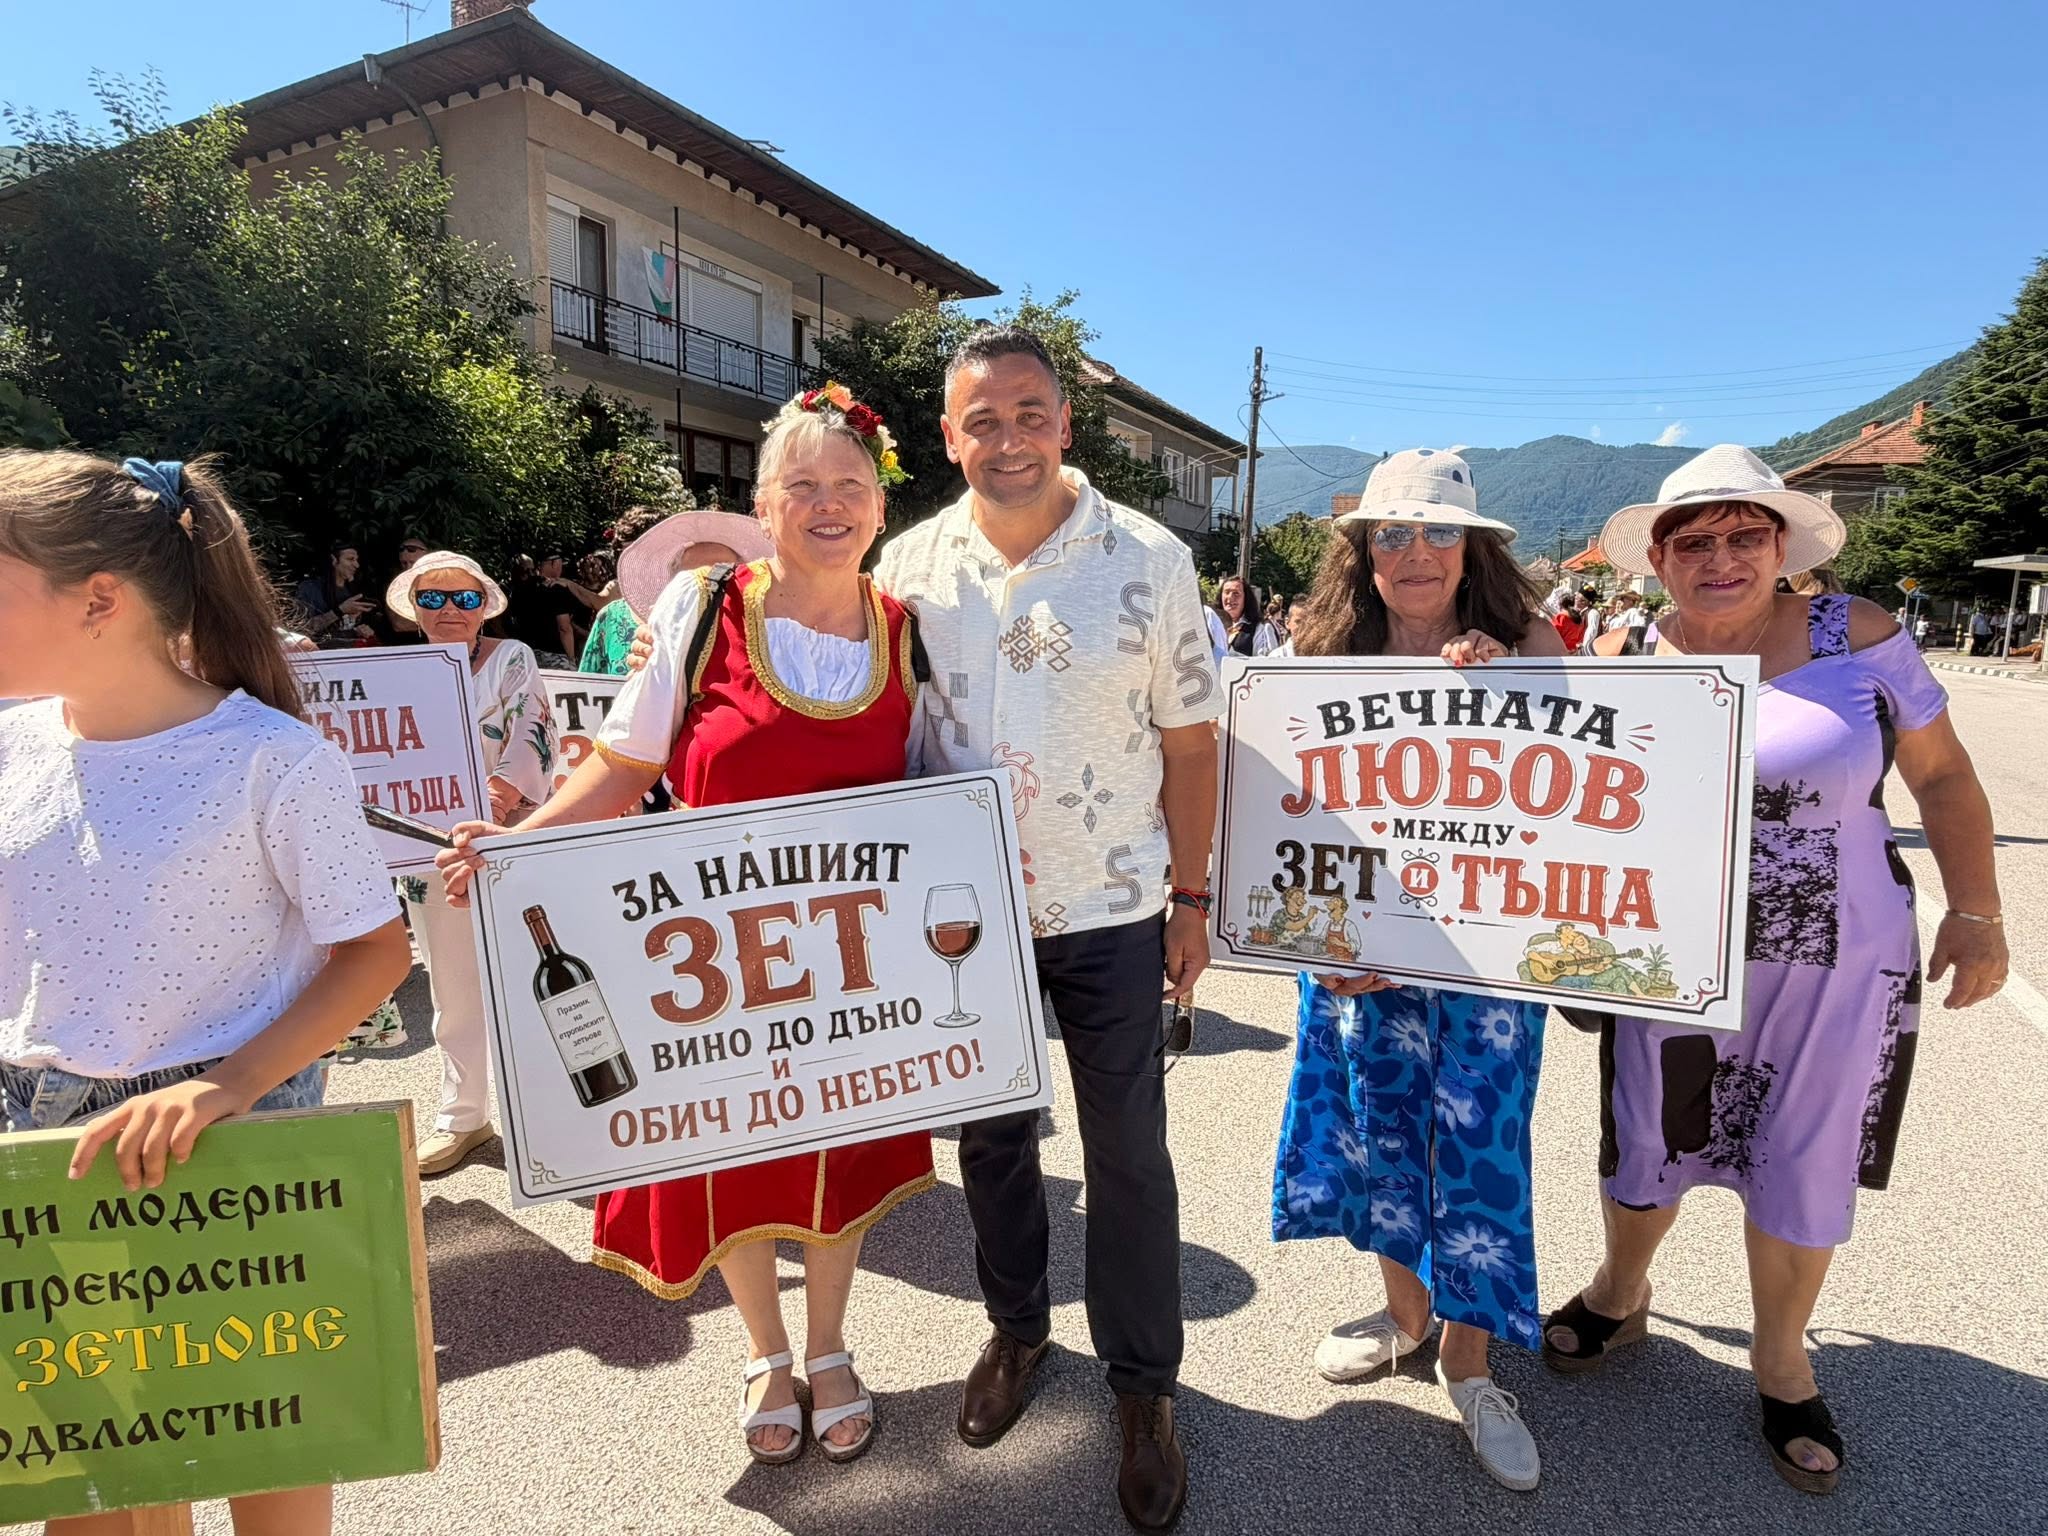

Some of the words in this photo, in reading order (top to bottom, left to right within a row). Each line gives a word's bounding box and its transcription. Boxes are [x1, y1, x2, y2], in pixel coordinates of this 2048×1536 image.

[1317, 688, 1618, 750] ВЕЧНАТА
[387, 774, 466, 816] ТЪЩА
[1280, 736, 1650, 834] ЛЮБОВ
[1392, 818, 1515, 848] МЕЖДУ
[612, 871, 683, 922] ЗА
[694, 842, 910, 900] НАШИЯТ
[1271, 839, 1387, 903] ЗЕТ
[1451, 853, 1661, 937] ТЪЩА
[644, 888, 889, 1026] ЗЕТ
[556, 998, 591, 1016] Празник
[573, 1013, 583, 1022] на
[650, 1027, 752, 1073] ВИНО
[767, 1016, 815, 1053] ДО
[828, 997, 923, 1044] ДЪНО
[608, 1096, 732, 1149] ОБИЧ
[747, 1084, 805, 1133] ДО
[817, 1038, 984, 1114] НЕБЕТО!
[13, 1306, 349, 1392] ЗЕТЬОВЕ
